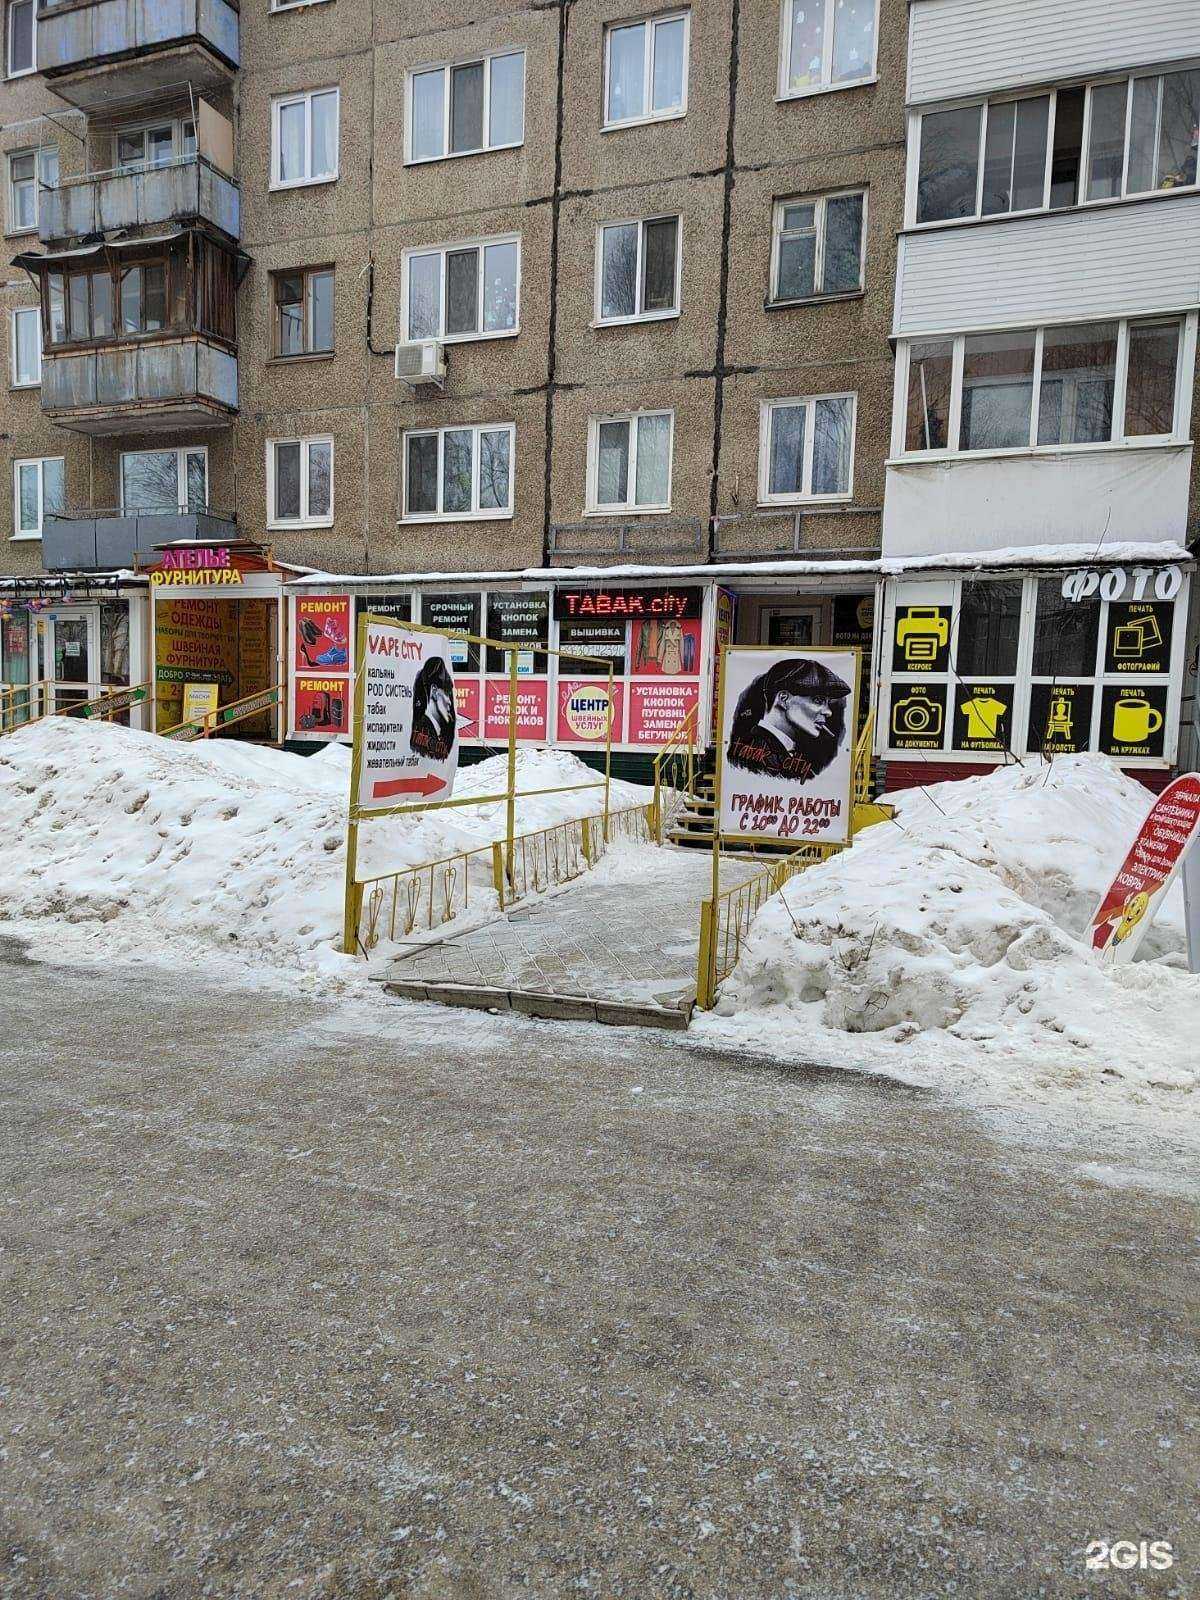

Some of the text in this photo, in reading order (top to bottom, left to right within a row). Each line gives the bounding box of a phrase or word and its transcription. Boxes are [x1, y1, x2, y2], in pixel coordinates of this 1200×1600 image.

[162, 548, 230, 569] АТЕЛЬЕ
[150, 568, 243, 586] ФУРНИТУРА
[1061, 566, 1183, 602] ФОТО
[300, 601, 348, 613] РЕМОНТ
[367, 604, 401, 613] РЕМОНТ
[430, 602, 474, 612] СРОЧНЫЙ
[492, 601, 547, 610] УСТАНОВКА
[1128, 604, 1154, 613] ПЕЧАТЬ
[171, 611, 222, 630] ОДЕЖДЫ
[433, 615, 469, 623] РЕМОНТ
[500, 613, 539, 622] КНОПОК
[501, 628, 539, 636] ЗАМЕНА
[570, 628, 621, 637] ВЫШИВКА
[172, 639, 222, 655] ШВЕЙНАЯ
[368, 635, 423, 661] VAPE CITY
[166, 653, 225, 668] ФУРНИТУРА
[907, 663, 932, 671] КСЕРОКС
[1117, 661, 1160, 671] ФОТОГРАФИЙ
[158, 669, 184, 680] ДОБРО
[367, 668, 395, 679] кальяны
[299, 680, 345, 693] РЕМОНТ
[367, 683, 384, 697] POD
[636, 686, 693, 696] УСТАНОВКА
[910, 686, 927, 694] ФОТО
[973, 687, 996, 695] ПЕЧАТЬ
[1120, 689, 1146, 697] ПЕЧАТЬ
[496, 694, 537, 704] РЕОНТ
[643, 698, 685, 707] КНОПОК
[367, 701, 386, 715] табак
[530, 706, 538, 715] И
[571, 699, 609, 712] ЦЕНТР
[571, 714, 607, 722] ШВЕЙНЫХ
[641, 708, 686, 719] ПУГОВИЦ
[487, 716, 544, 725] РЮКАКОВ
[366, 722, 403, 735] испарители
[575, 722, 604, 730] УСЛУГ
[366, 740, 396, 752] жидкости
[904, 740, 939, 750] ДОКУМЕНТЫ
[961, 741, 970, 749] НА
[366, 755, 405, 769] жевательный
[731, 793, 842, 817] ГРАФИК РАБОТЫ
[739, 812, 749, 830] С
[777, 815, 800, 838] ДО
[1131, 862, 1168, 881] ЭЛЕКТРИКА
[1118, 871, 1146, 891] КОВРЫ
